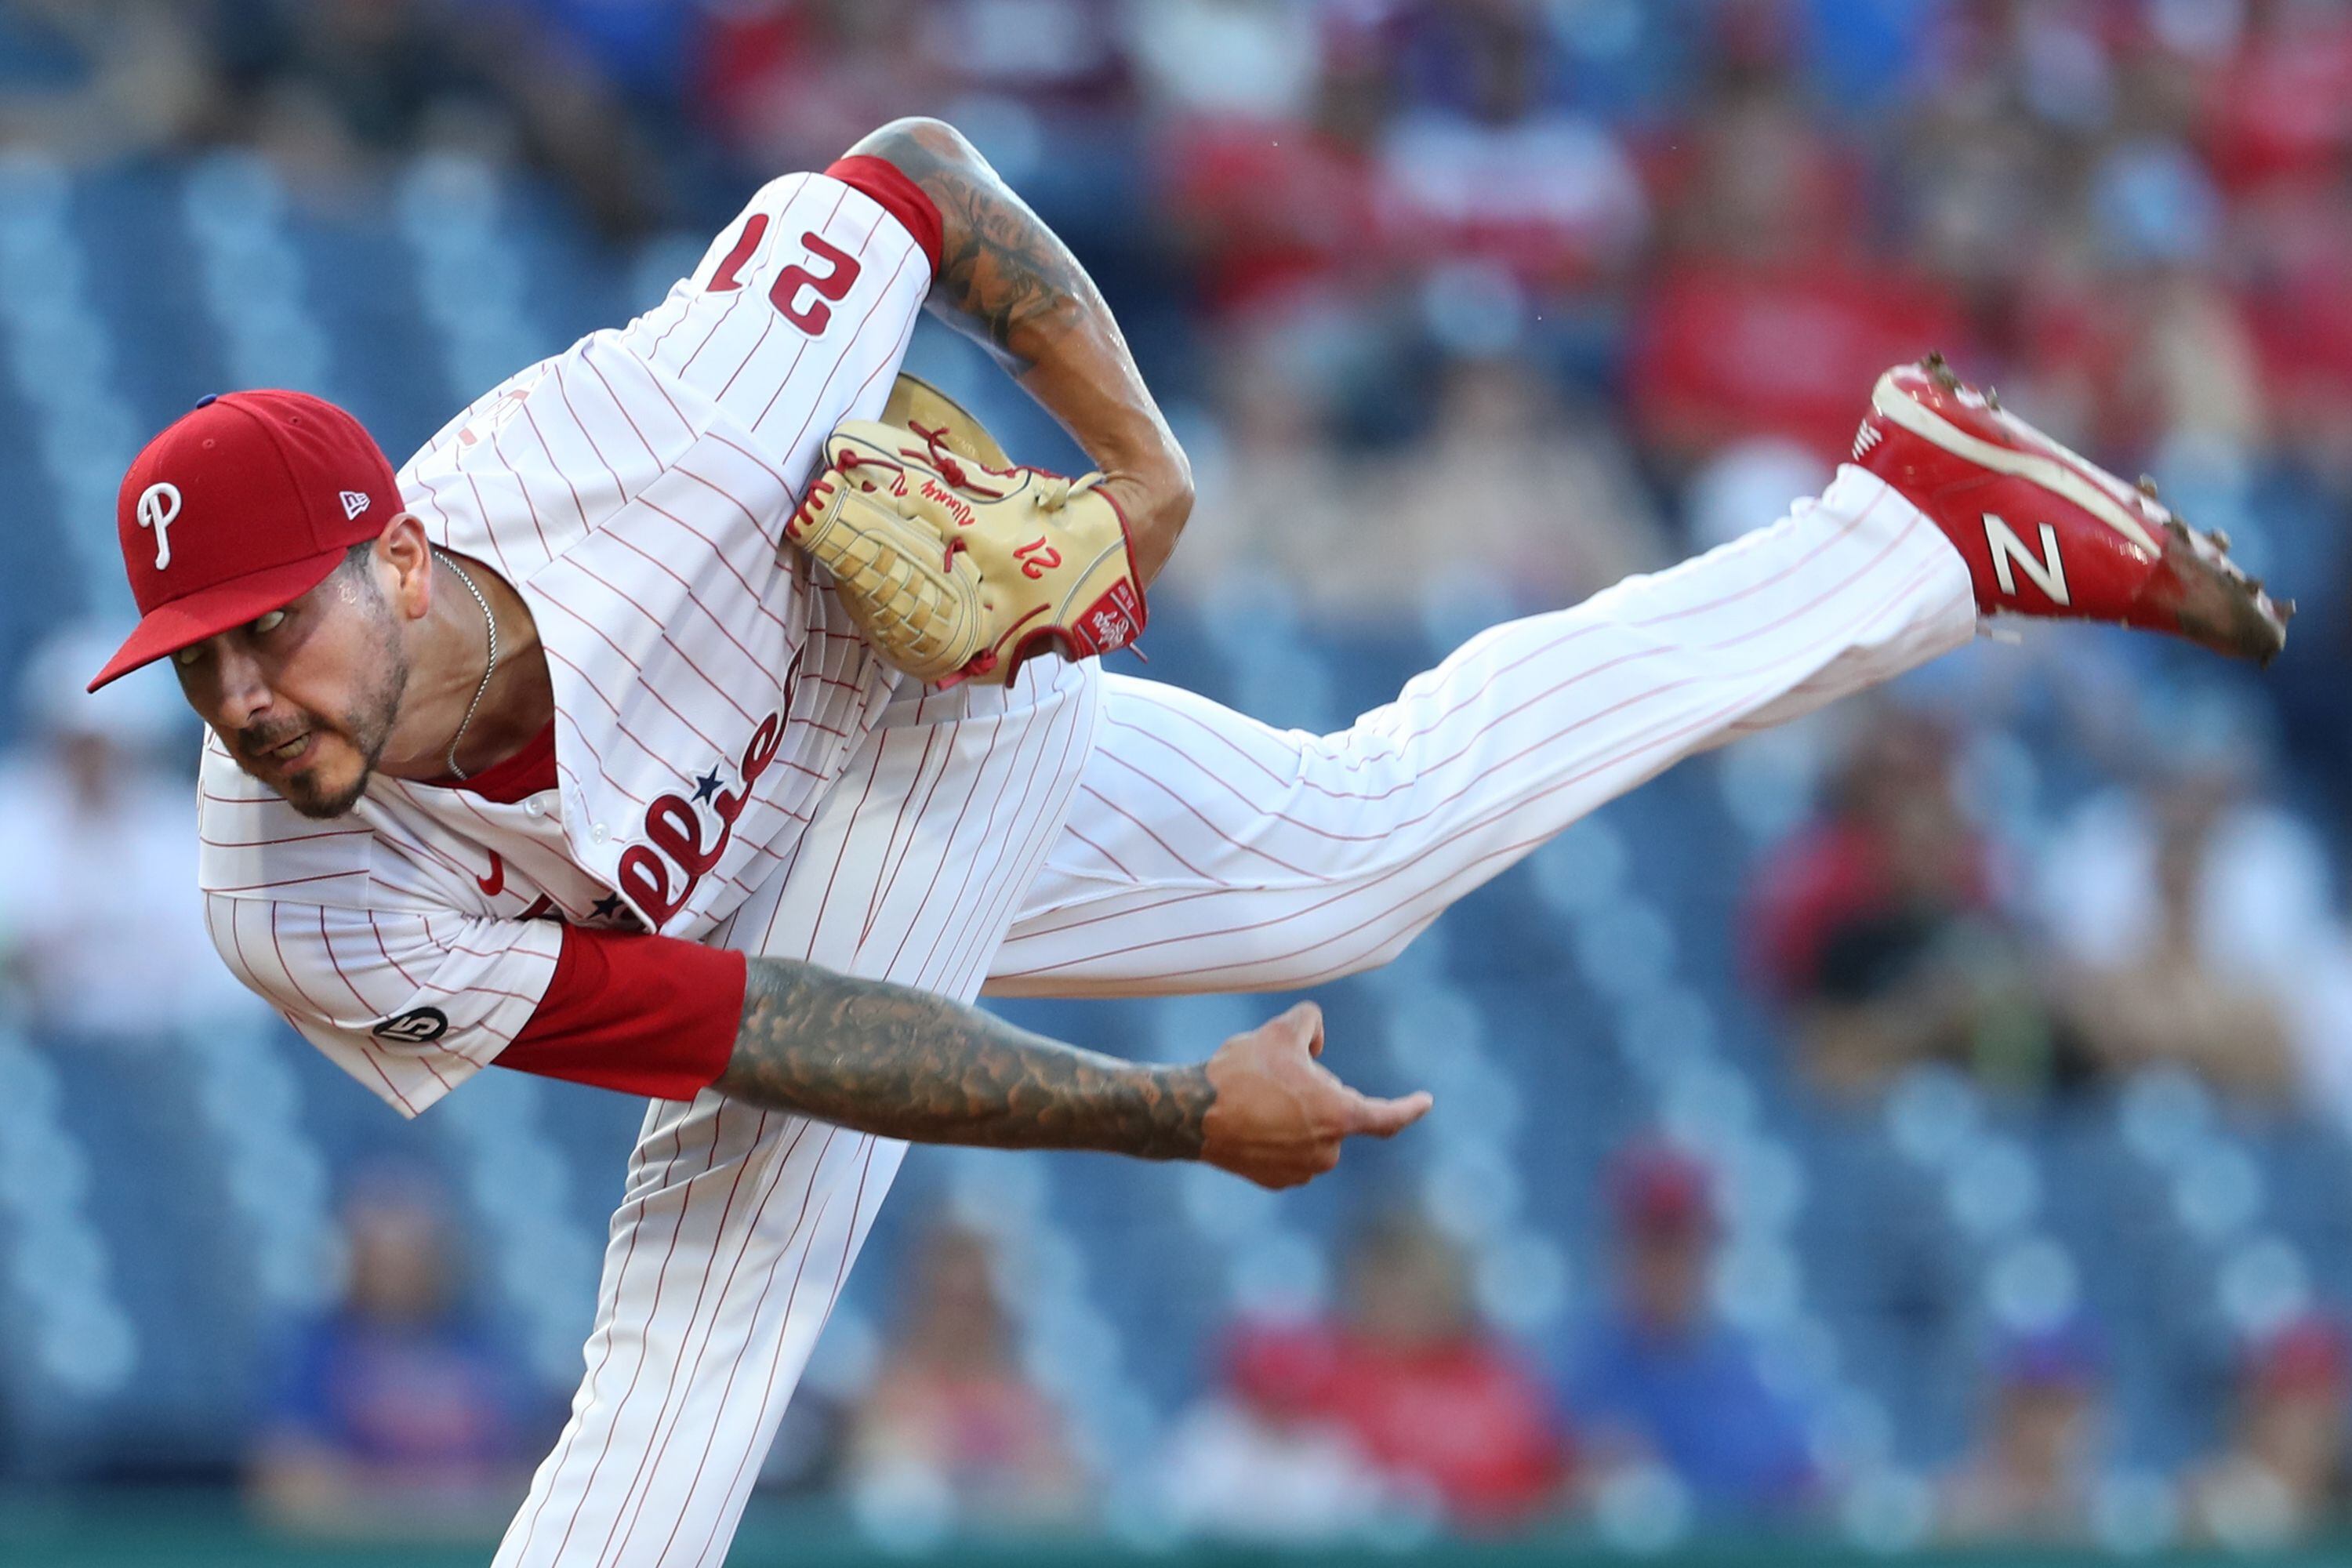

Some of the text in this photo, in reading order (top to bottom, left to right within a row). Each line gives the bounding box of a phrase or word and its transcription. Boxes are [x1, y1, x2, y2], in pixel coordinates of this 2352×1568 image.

[706, 212, 862, 336] 21
[136, 481, 183, 571] P
[920, 478, 975, 526] Vinny
[1012, 534, 1062, 580] 21
[1981, 511, 2071, 606] N
[379, 1015, 441, 1043] 15
